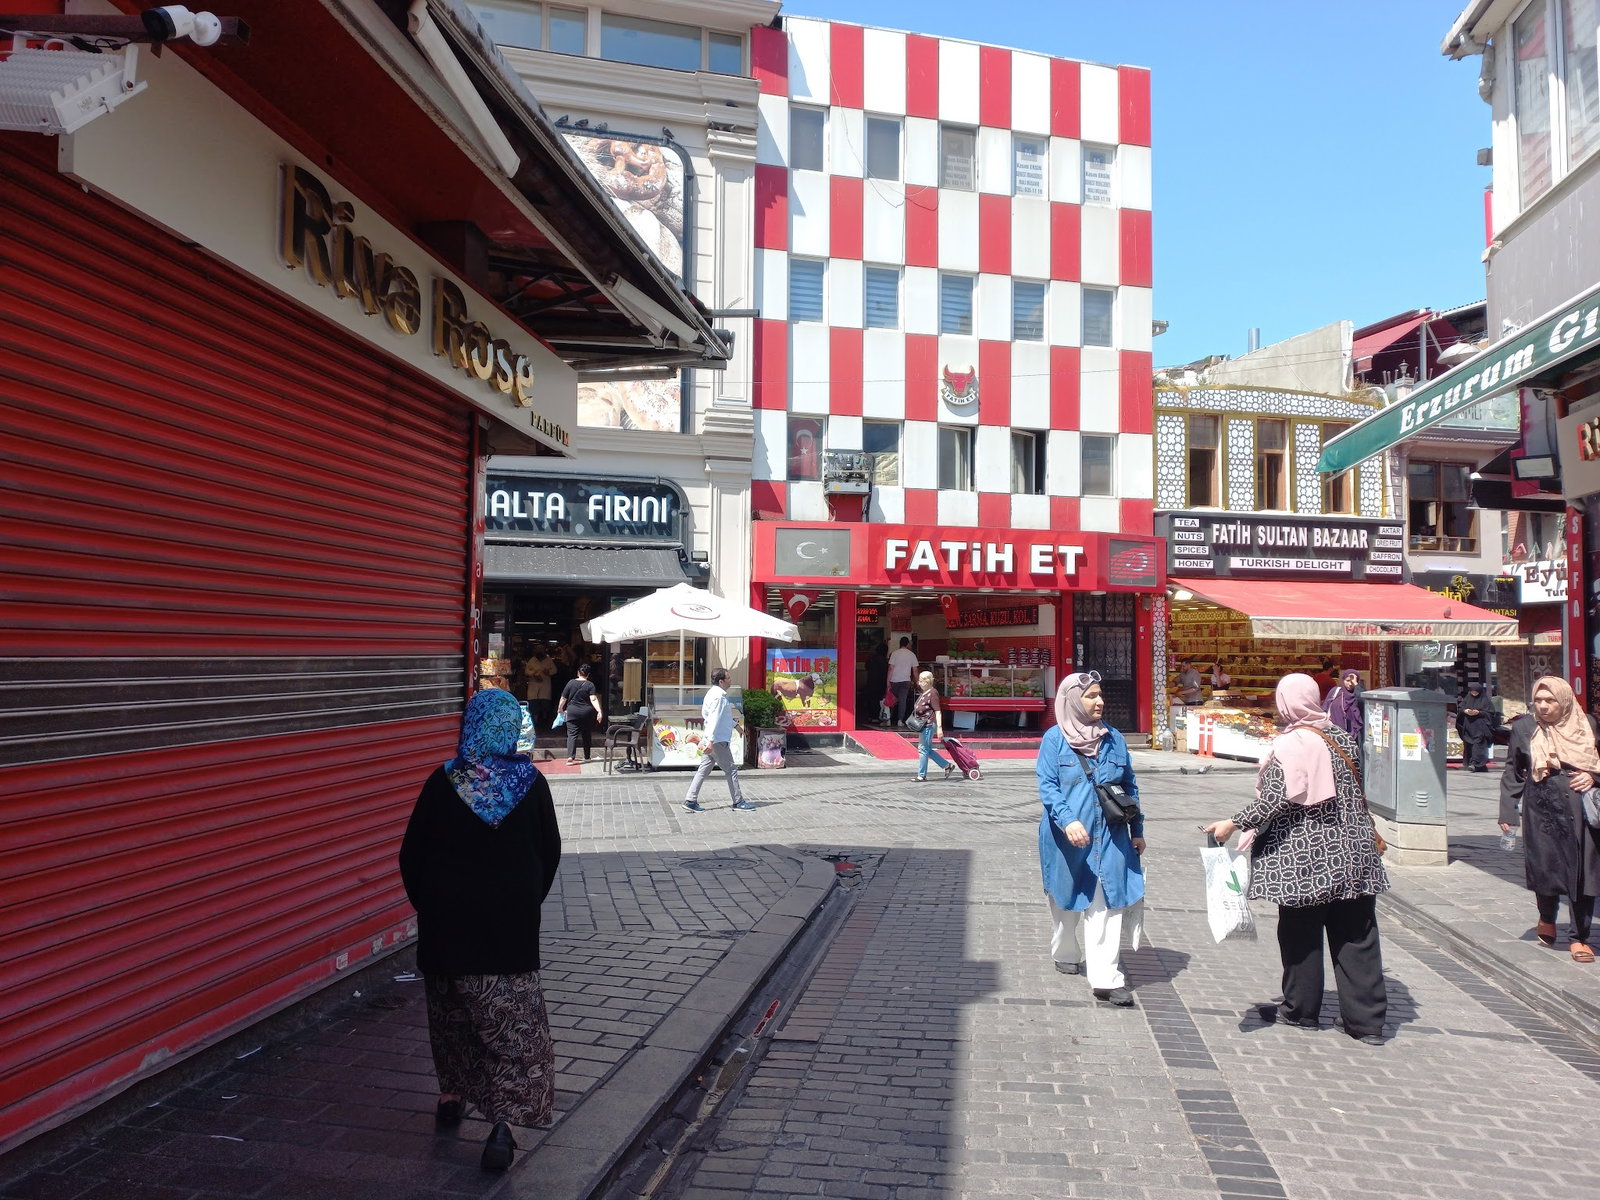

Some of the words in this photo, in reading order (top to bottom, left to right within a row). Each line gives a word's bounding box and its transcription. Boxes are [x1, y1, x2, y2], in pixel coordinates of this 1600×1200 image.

[431, 276, 535, 408] Rose
[1400, 344, 1535, 434] Erzurum
[588, 494, 667, 523] FIRINI
[1177, 519, 1197, 527] TEA
[1257, 524, 1308, 547] SULTAN
[1313, 527, 1369, 549] BAZAAR
[1030, 544, 1085, 575] ET
[1178, 560, 1211, 568] HONEY
[1239, 558, 1290, 568] TURKISH
[1295, 560, 1344, 570] DELIGHT
[1571, 516, 1581, 618] SEFA
[815, 657, 831, 672] ET
